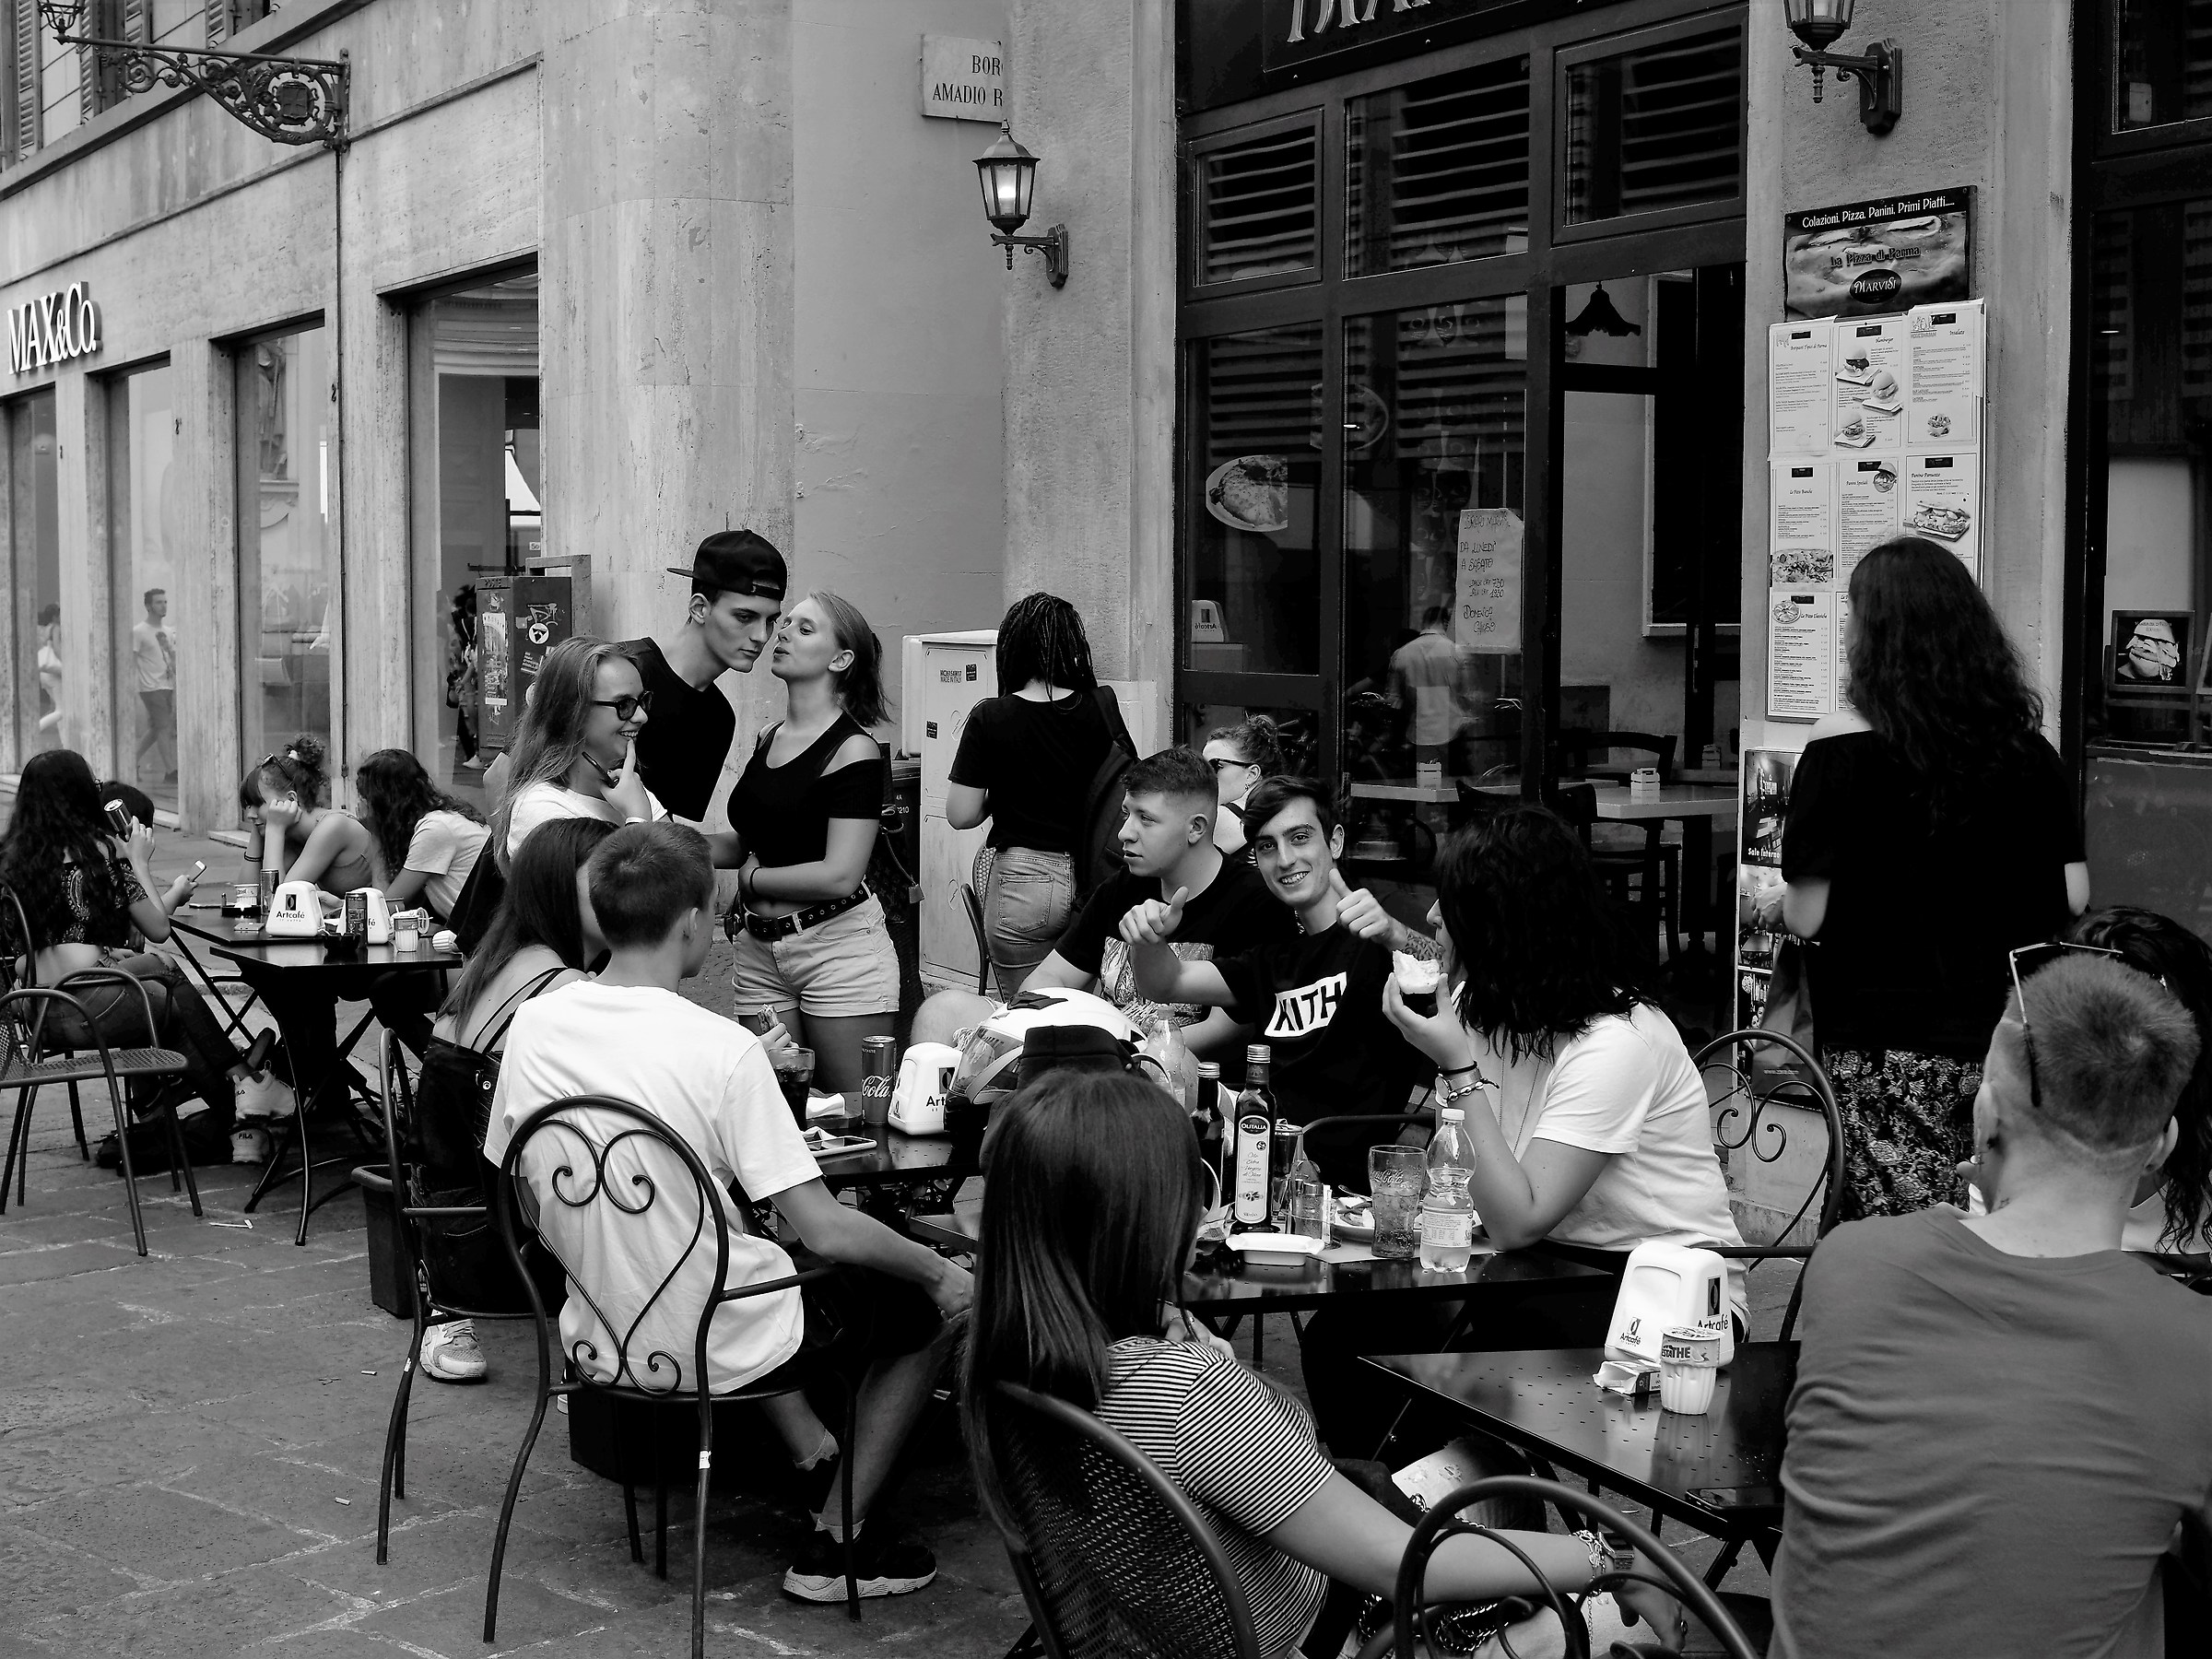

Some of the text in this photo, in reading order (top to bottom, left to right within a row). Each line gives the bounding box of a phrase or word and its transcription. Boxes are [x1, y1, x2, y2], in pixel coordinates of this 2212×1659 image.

[971, 55, 1004, 76] BOR
[933, 83, 986, 105] AMADIO
[1898, 199, 1921, 214] Primi
[1830, 256, 1842, 268] La
[1846, 251, 1872, 266] Pizza
[1889, 246, 1921, 260] Parma
[276, 911, 305, 919] Artcafé
[1241, 1123, 1266, 1131] OLITALIA
